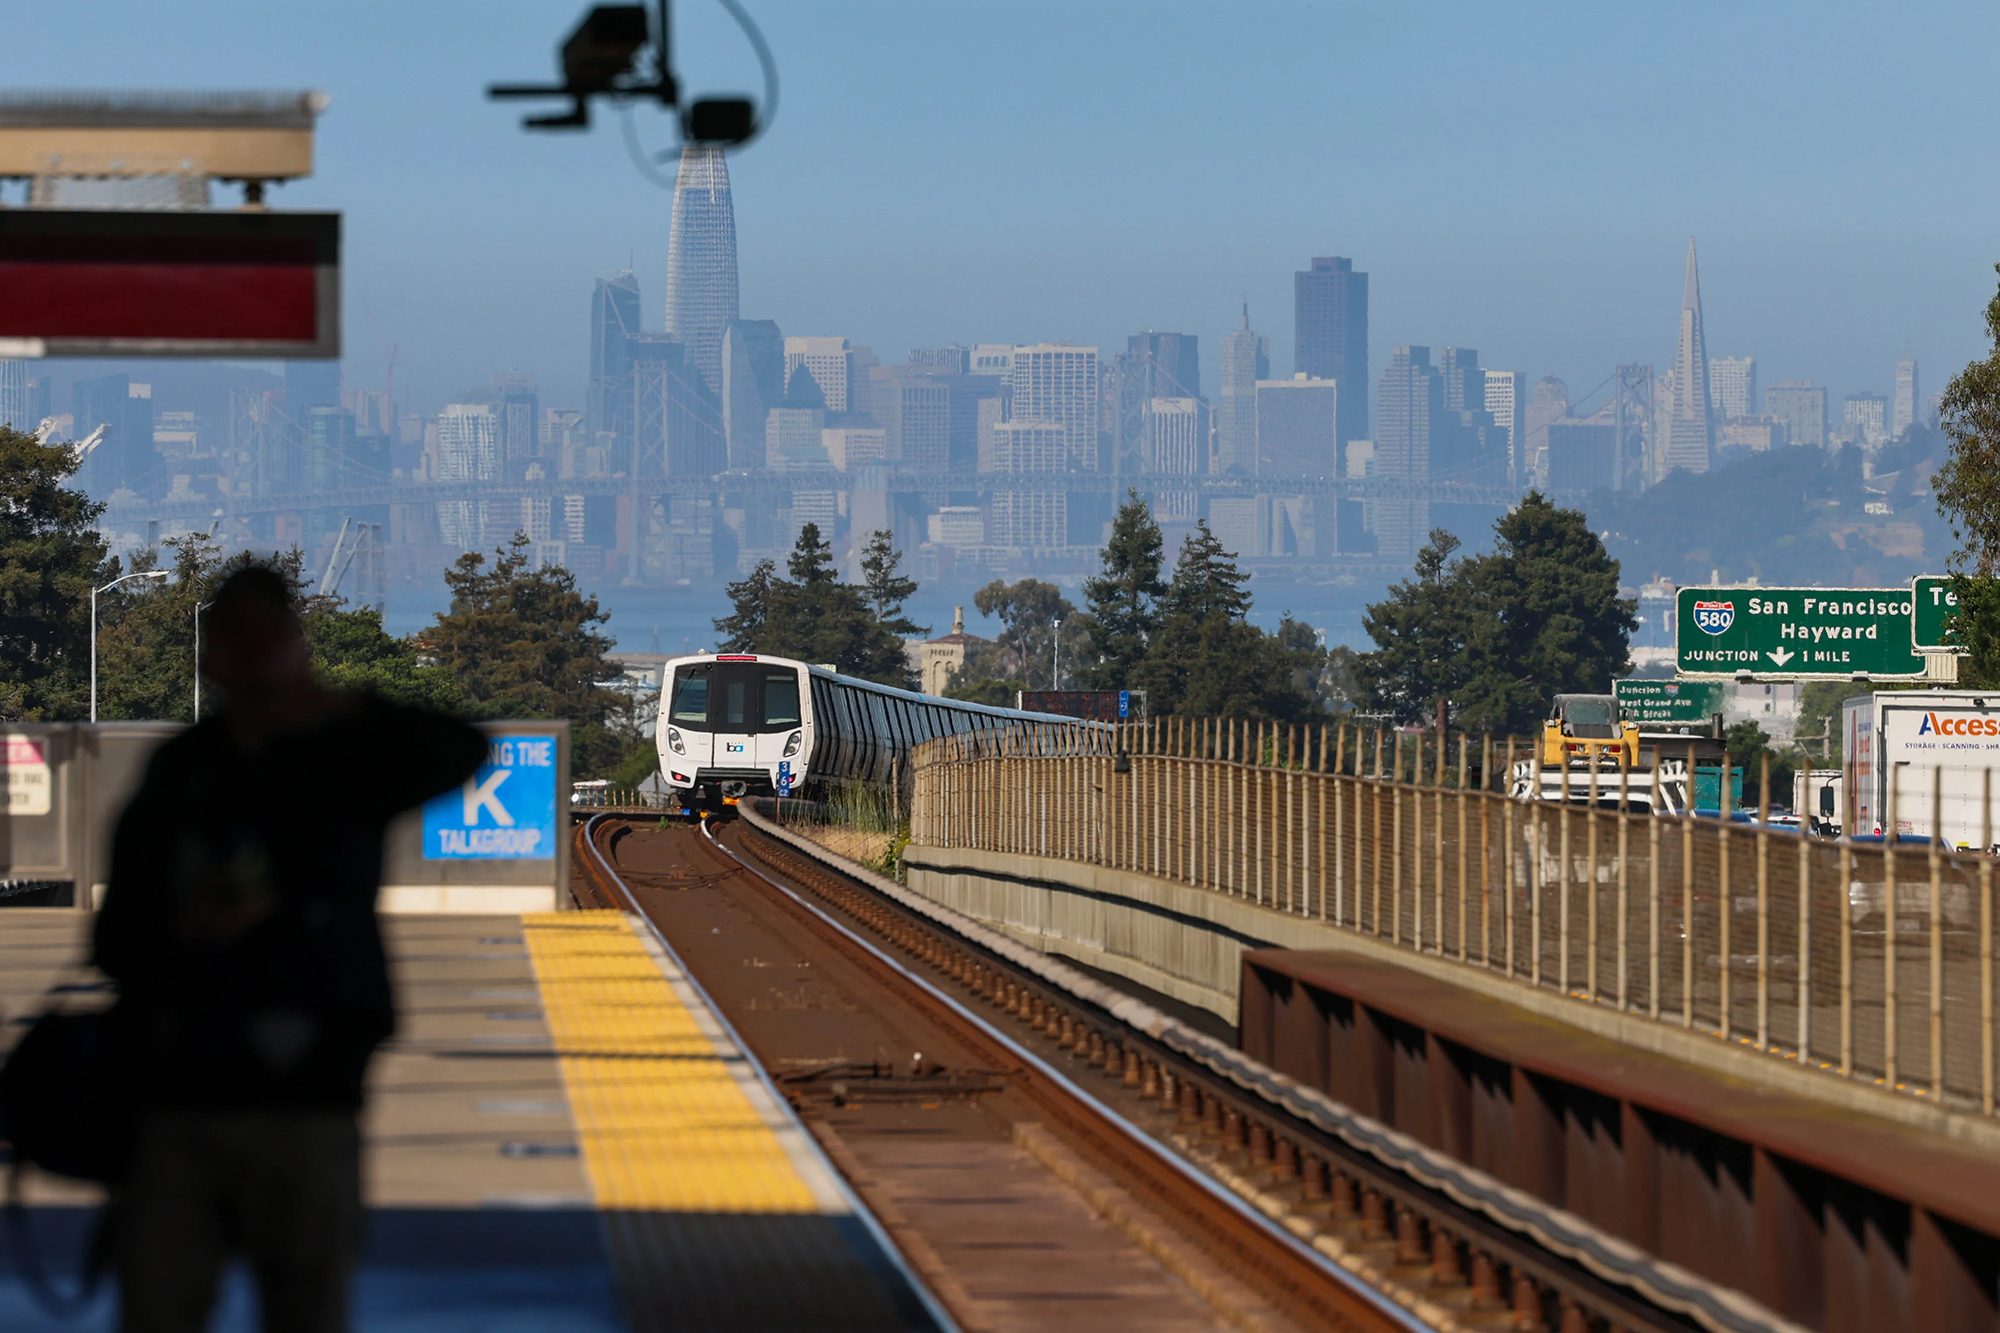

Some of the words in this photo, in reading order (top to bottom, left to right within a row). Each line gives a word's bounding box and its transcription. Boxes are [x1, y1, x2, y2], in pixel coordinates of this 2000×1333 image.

[1748, 598, 1789, 615] San
[1804, 598, 1911, 616] Francisco
[1699, 612, 1731, 628] 580
[1781, 623, 1877, 643] Hayward
[1684, 650, 1759, 662] JUNCTION
[1802, 650, 1808, 662] 1
[1814, 651, 1850, 662] MILE
[1619, 685, 1661, 694] Junction
[1619, 698, 1641, 707] West
[1643, 698, 1671, 707] Grand
[1918, 712, 2000, 737] Acces
[517, 741, 552, 767] THE
[1942, 742, 1980, 750] SCANNING
[781, 762, 788, 772] 3
[780, 776, 788, 786] 6
[462, 769, 515, 827] K
[438, 828, 541, 854] TALKGROUP
